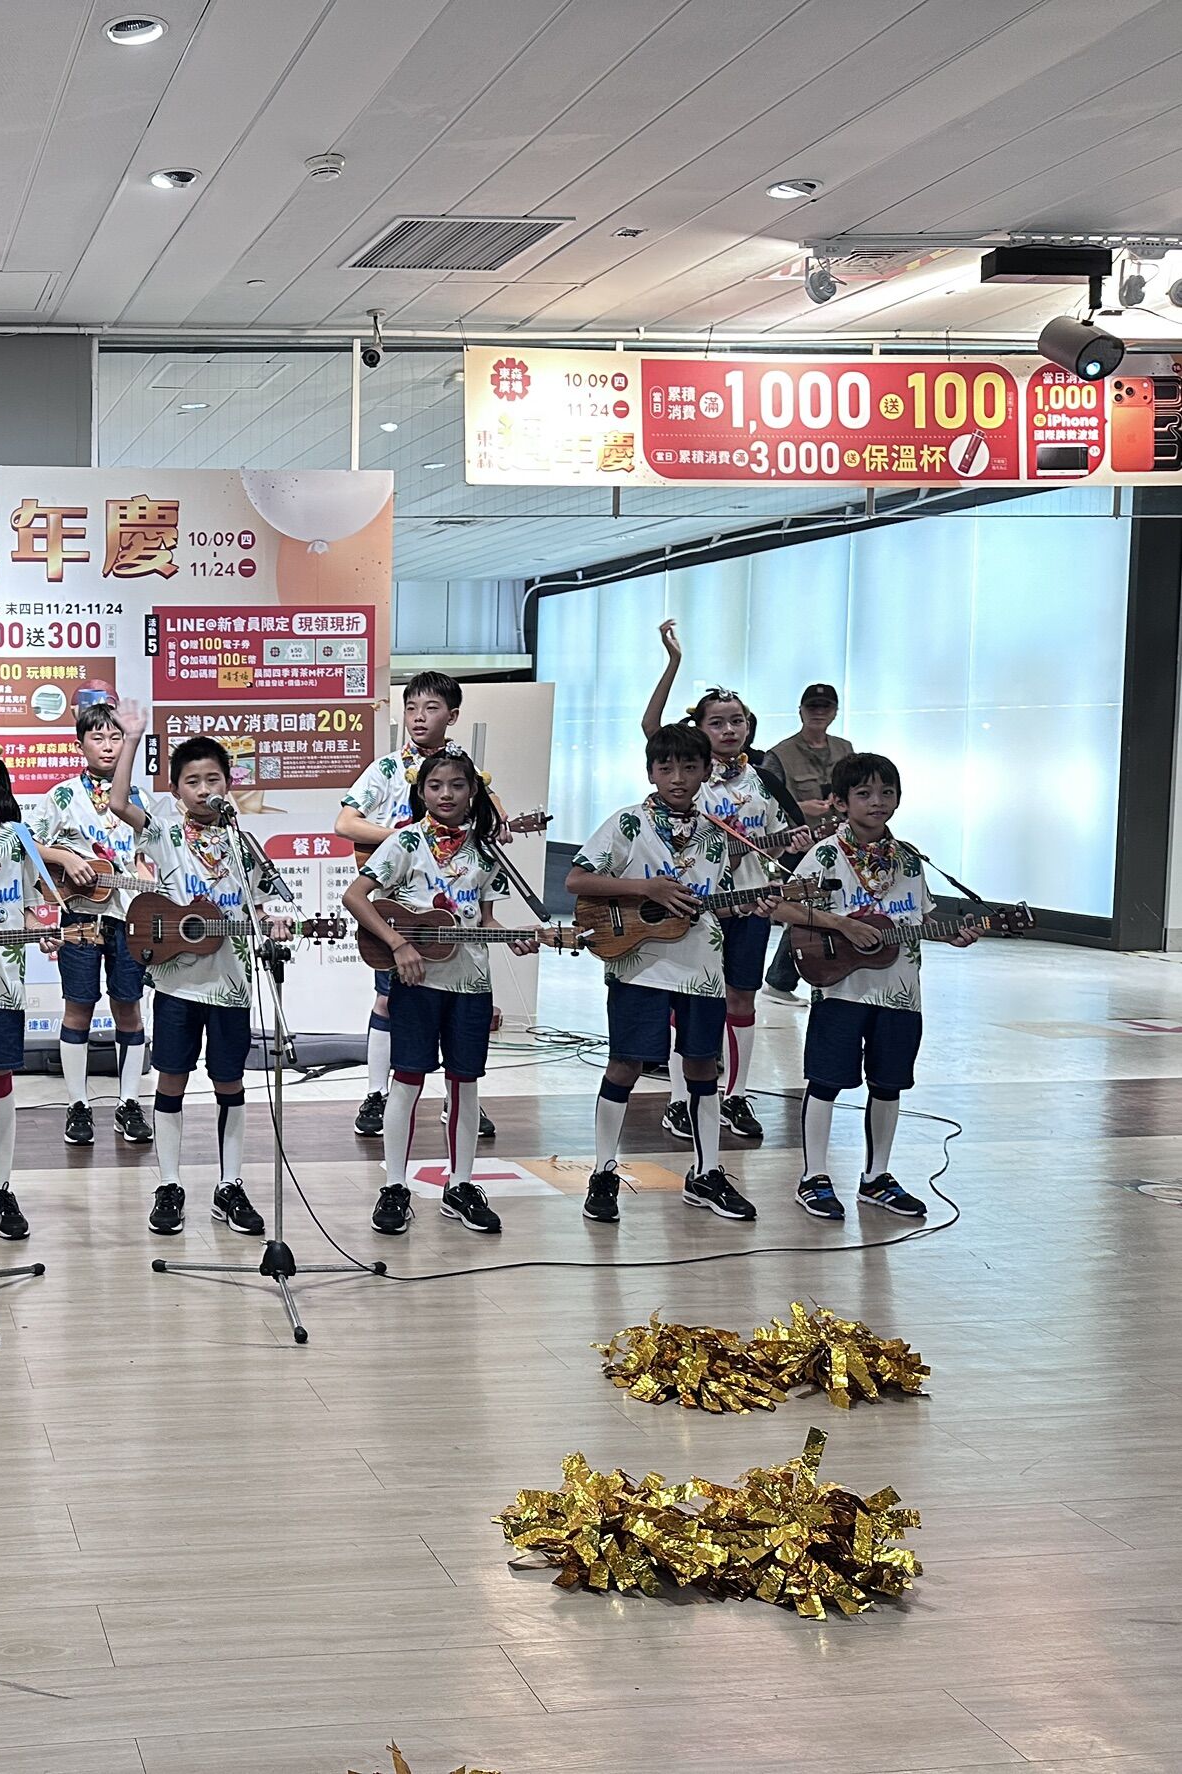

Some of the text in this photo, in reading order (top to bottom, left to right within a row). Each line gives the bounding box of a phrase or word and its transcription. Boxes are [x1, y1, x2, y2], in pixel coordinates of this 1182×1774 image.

[668, 386, 696, 402] 累積
[1034, 385, 1097, 412] 1,000
[725, 371, 871, 434] 1,000
[907, 372, 1006, 430] 100
[668, 405, 696, 420] 消費
[1048, 413, 1099, 428] iPhone
[679, 450, 730, 464] 累積消費
[749, 440, 840, 477] 3,000
[862, 444, 947, 473] 保溫杯
[188, 531, 235, 547] 10/09
[190, 562, 236, 577] 11/24
[166, 616, 361, 632] LINE@新會員限定 現領現折
[312, 738, 362, 753] 信用至上
[293, 837, 331, 856] 餐飲
